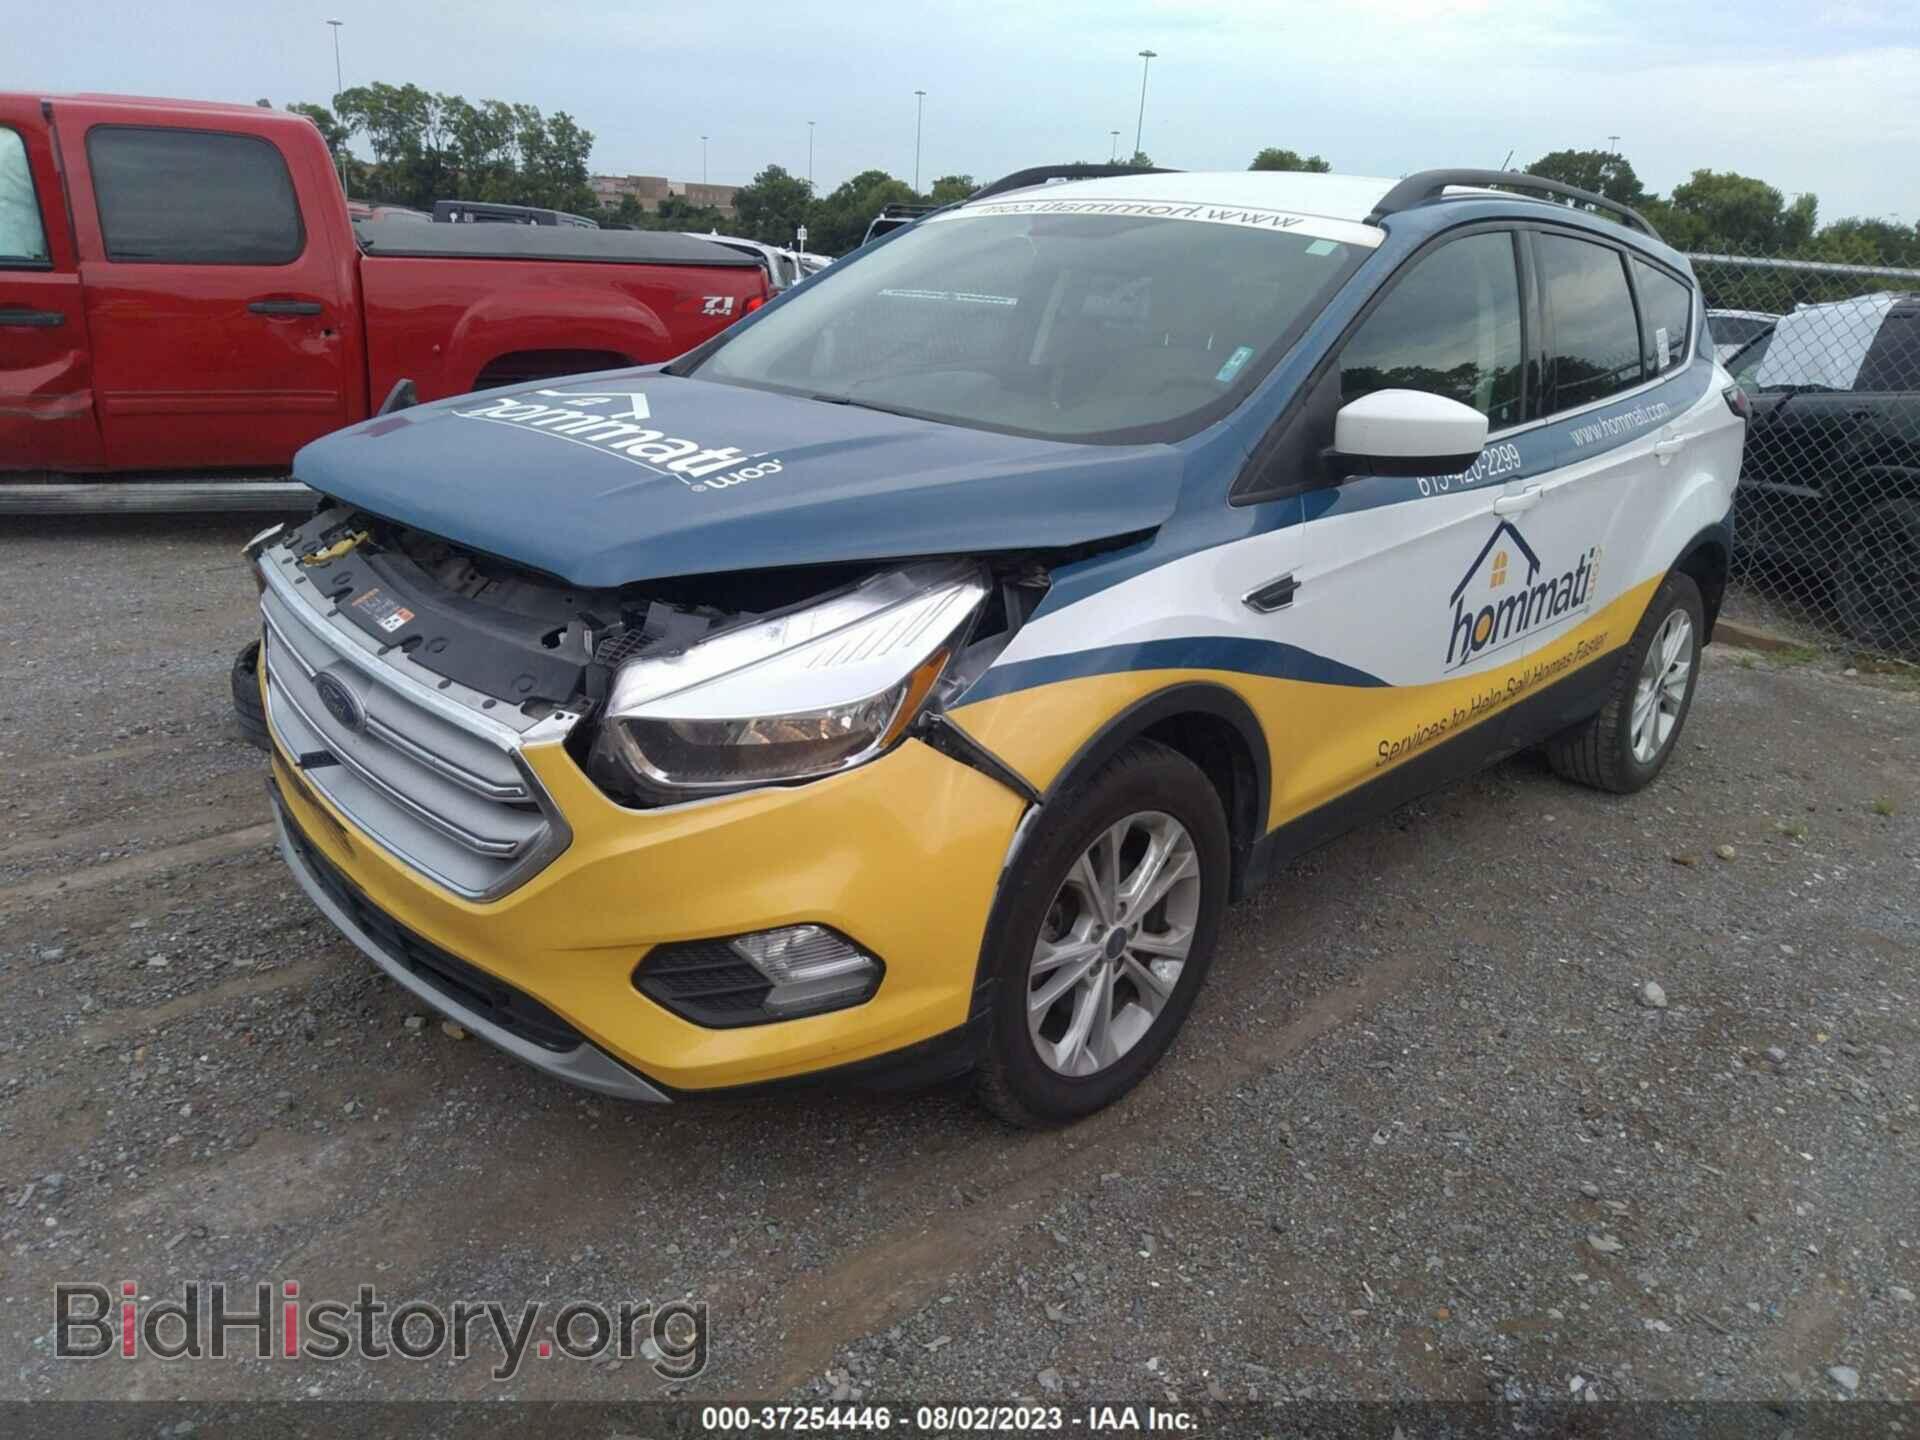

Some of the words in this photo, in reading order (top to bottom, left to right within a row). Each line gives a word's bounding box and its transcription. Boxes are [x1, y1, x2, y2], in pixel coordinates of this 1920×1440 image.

[703, 458, 783, 489] .com
[1446, 546, 1595, 666] hommati
[1376, 717, 1447, 767] Services
[1450, 708, 1465, 729] to
